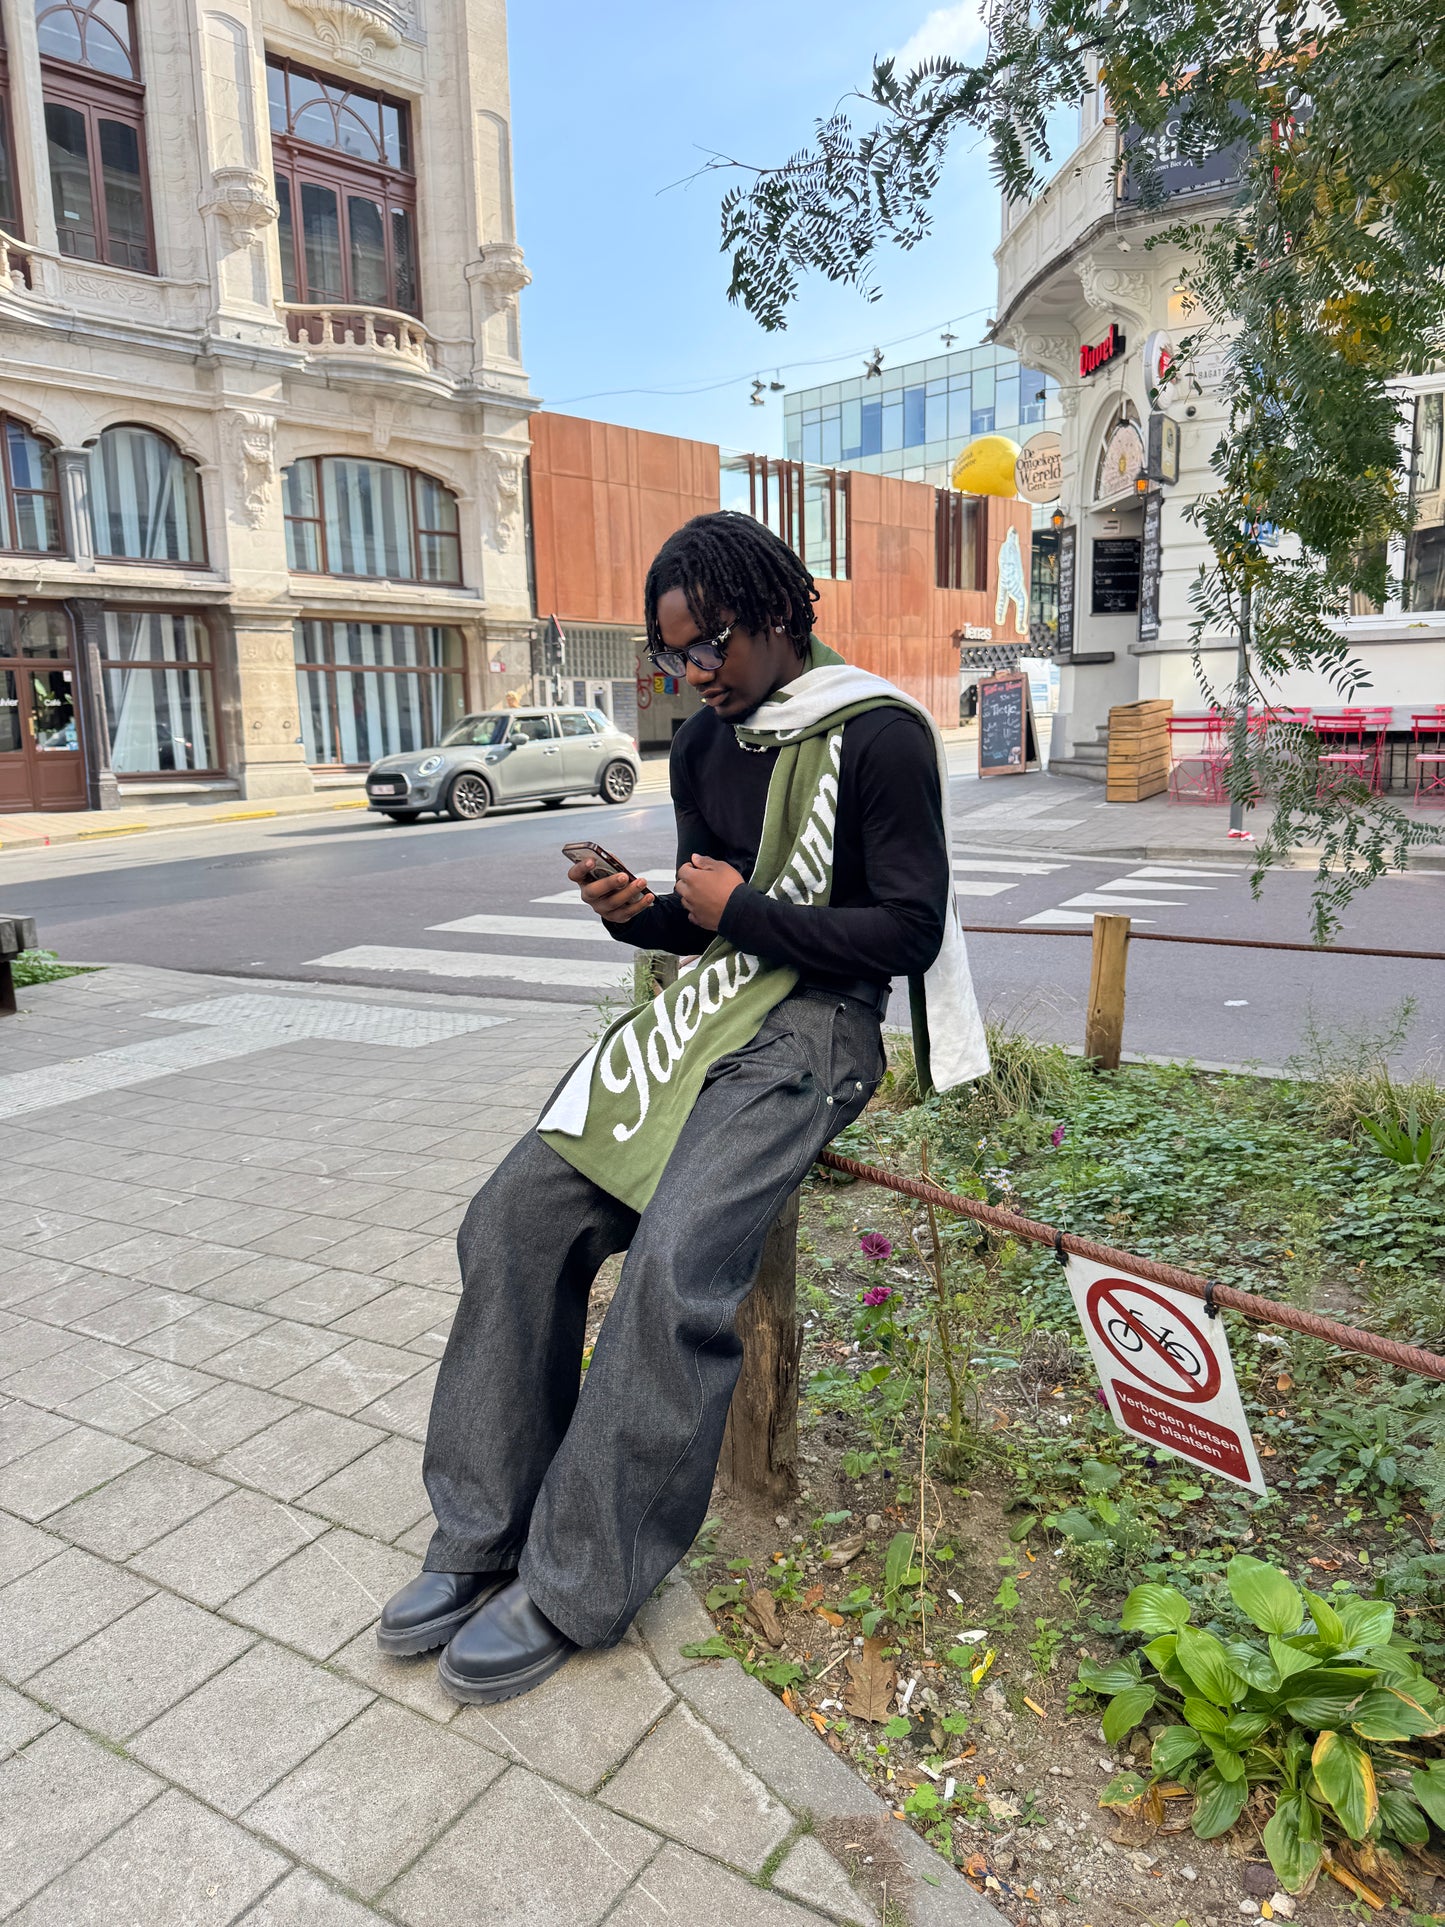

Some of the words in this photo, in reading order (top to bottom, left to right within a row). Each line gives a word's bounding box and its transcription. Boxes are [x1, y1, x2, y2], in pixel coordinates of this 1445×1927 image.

[1079, 323, 1114, 378] Duvel
[1016, 453, 1061, 471] Omgekeer
[1023, 448, 1036, 461] De
[1019, 463, 1061, 486] Wereld
[1026, 482, 1046, 493] Gent
[963, 622, 993, 640] Terras
[599, 951, 760, 1143] Ideas
[1116, 1390, 1186, 1430] Verboden
[1187, 1423, 1240, 1454] fietsen
[1142, 1415, 1156, 1429] te
[1159, 1424, 1222, 1459] plaatsen
